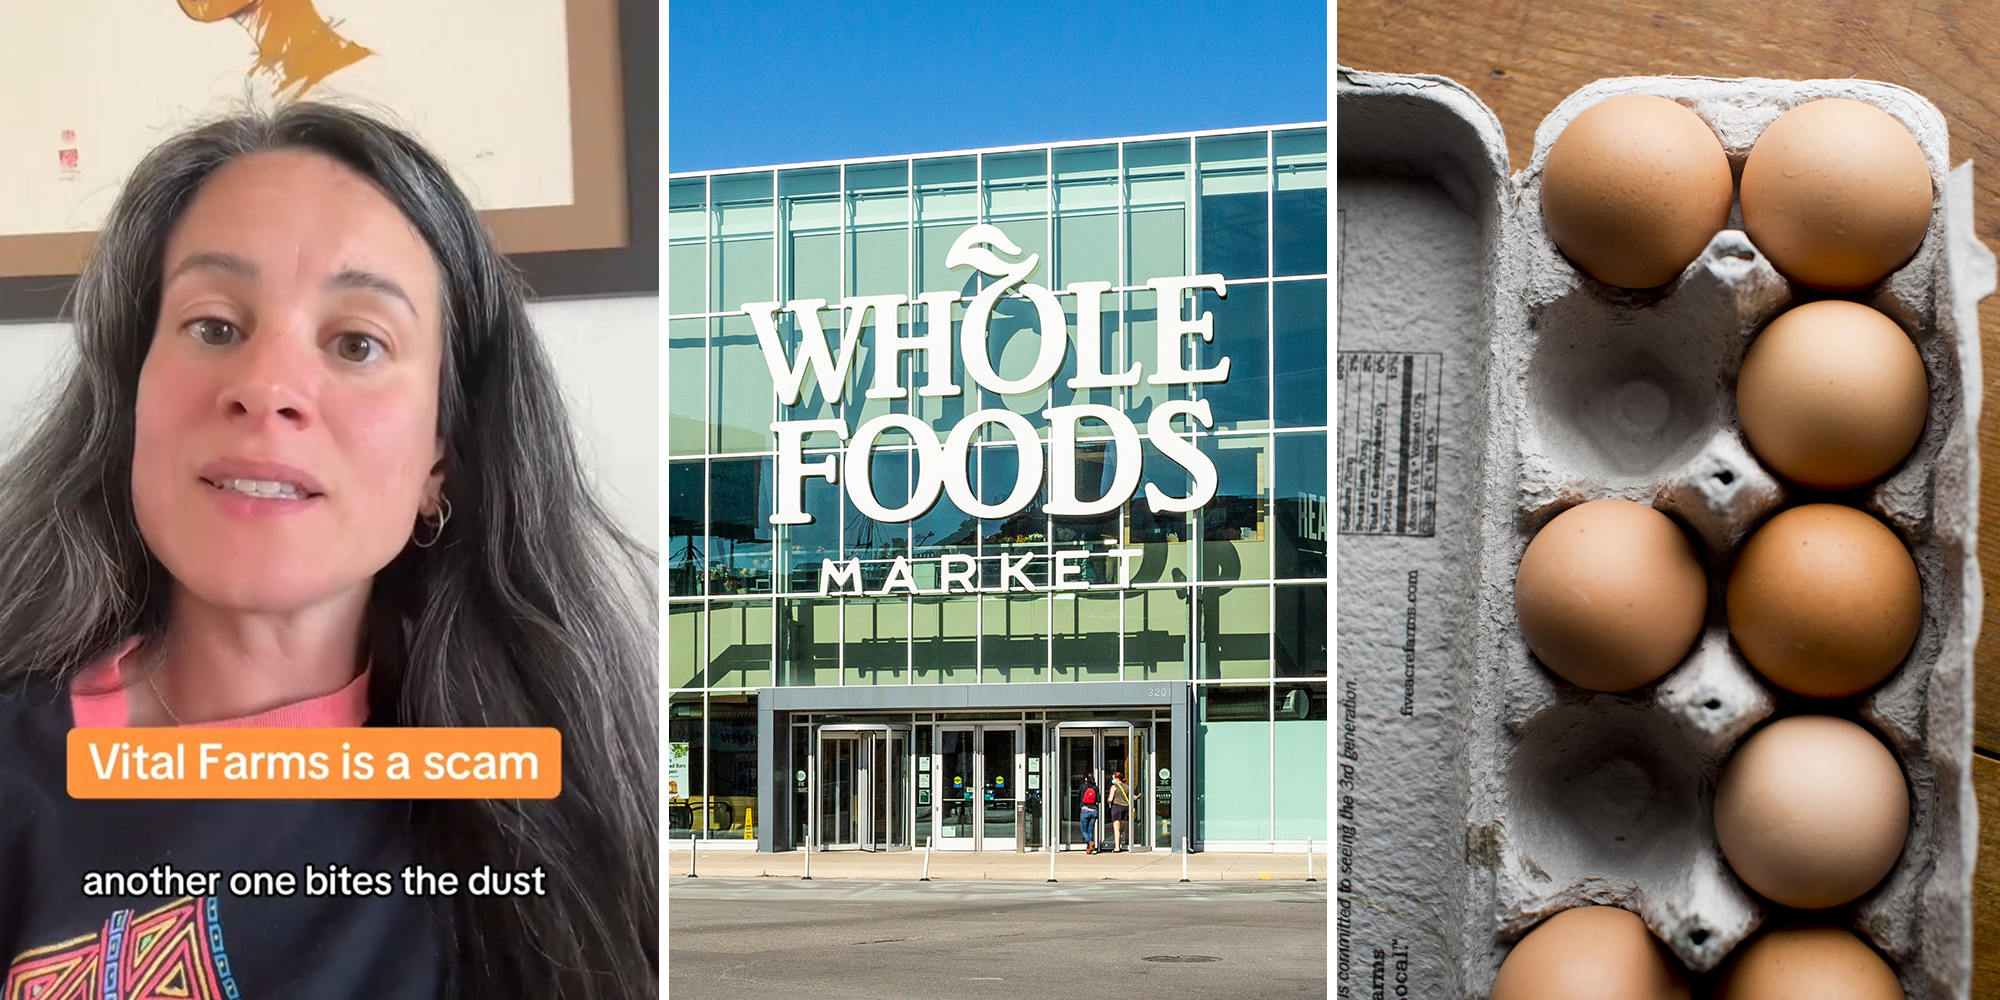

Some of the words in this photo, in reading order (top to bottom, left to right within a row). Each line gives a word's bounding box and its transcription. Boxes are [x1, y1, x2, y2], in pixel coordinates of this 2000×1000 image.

[741, 224, 1231, 407] WHOLE
[769, 399, 1219, 525] FOODS
[1370, 418, 1384, 499] Carbohydrate
[1341, 487, 1352, 532] Sodium
[1355, 469, 1367, 532] Potassium
[1368, 502, 1379, 533] Total
[1382, 490, 1393, 533] Protein
[1407, 497, 1417, 534] Vitamin
[819, 548, 1144, 597] MARKET
[1399, 569, 1418, 717] fiveacrefarms.com
[1148, 688, 1172, 697] 3201
[1342, 677, 1359, 761] generation.
[1339, 763, 1354, 791] 3rd
[1339, 796, 1354, 820] the
[1338, 825, 1356, 875] seeing
[1337, 878, 1352, 894] to
[1337, 899, 1351, 981] committed
[1337, 986, 1349, 999] is
